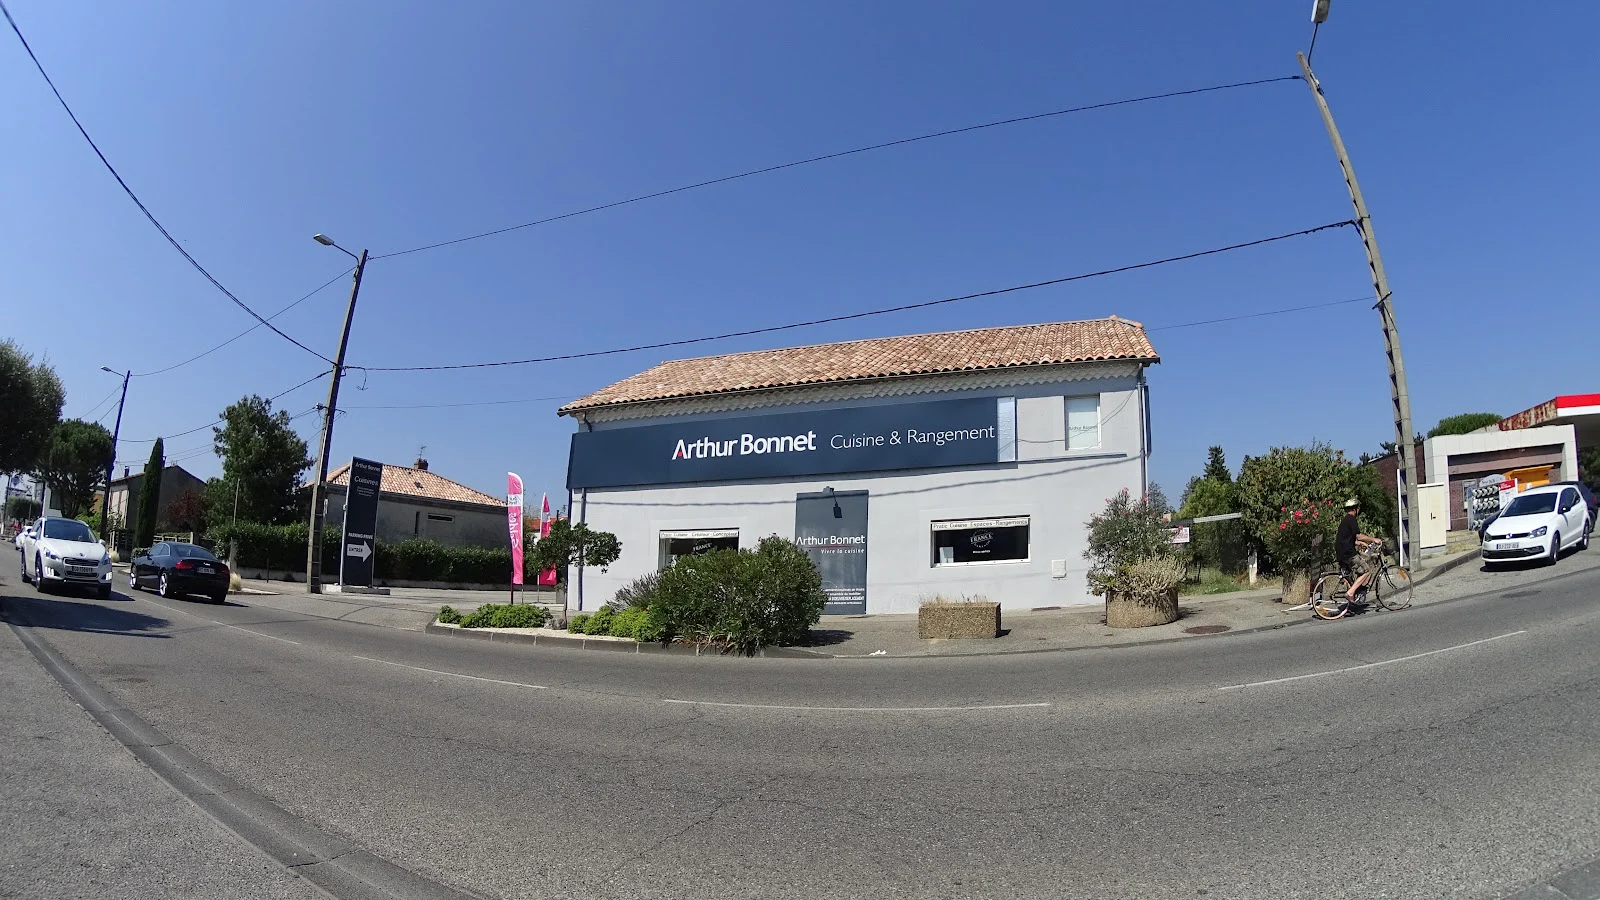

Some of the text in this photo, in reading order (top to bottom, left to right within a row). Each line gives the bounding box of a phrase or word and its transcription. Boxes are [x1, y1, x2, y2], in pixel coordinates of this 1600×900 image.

[672, 425, 995, 460] Arthur Bonnet Cuisine & Rangement
[795, 534, 866, 546] Arthur Bonnet
